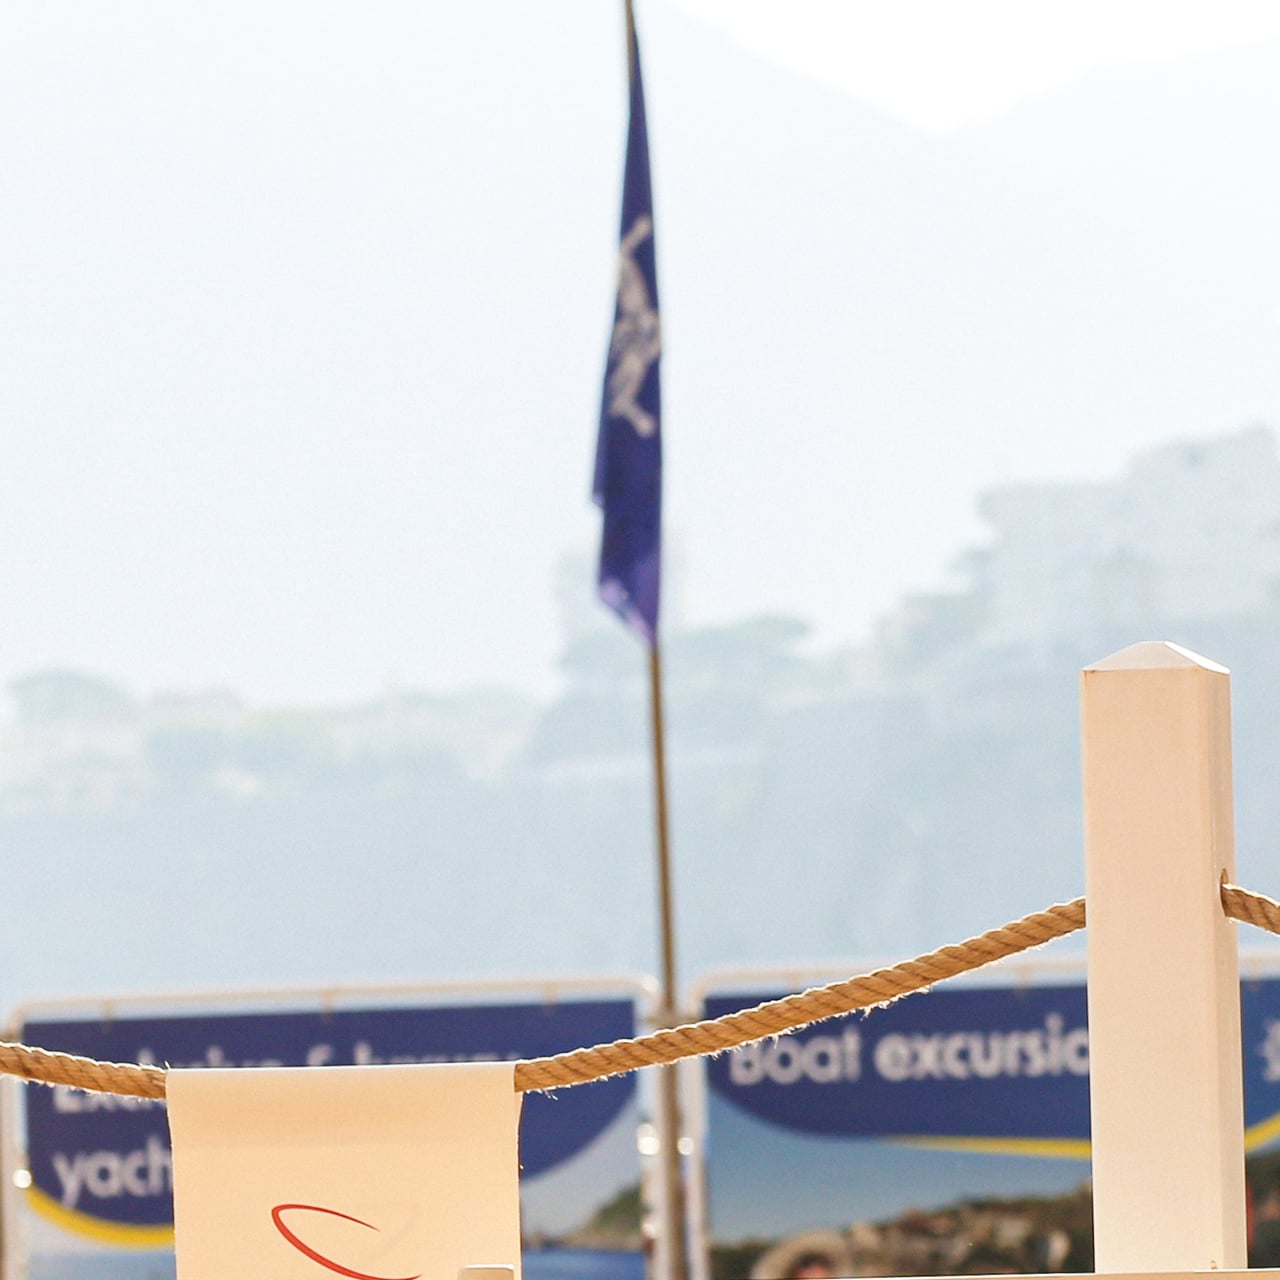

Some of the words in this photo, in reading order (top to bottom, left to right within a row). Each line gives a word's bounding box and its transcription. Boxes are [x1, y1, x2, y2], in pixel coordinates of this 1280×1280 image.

[730, 1025, 861, 1086] Boat
[874, 1012, 1090, 1082] excursio
[52, 1132, 173, 1208] yach
